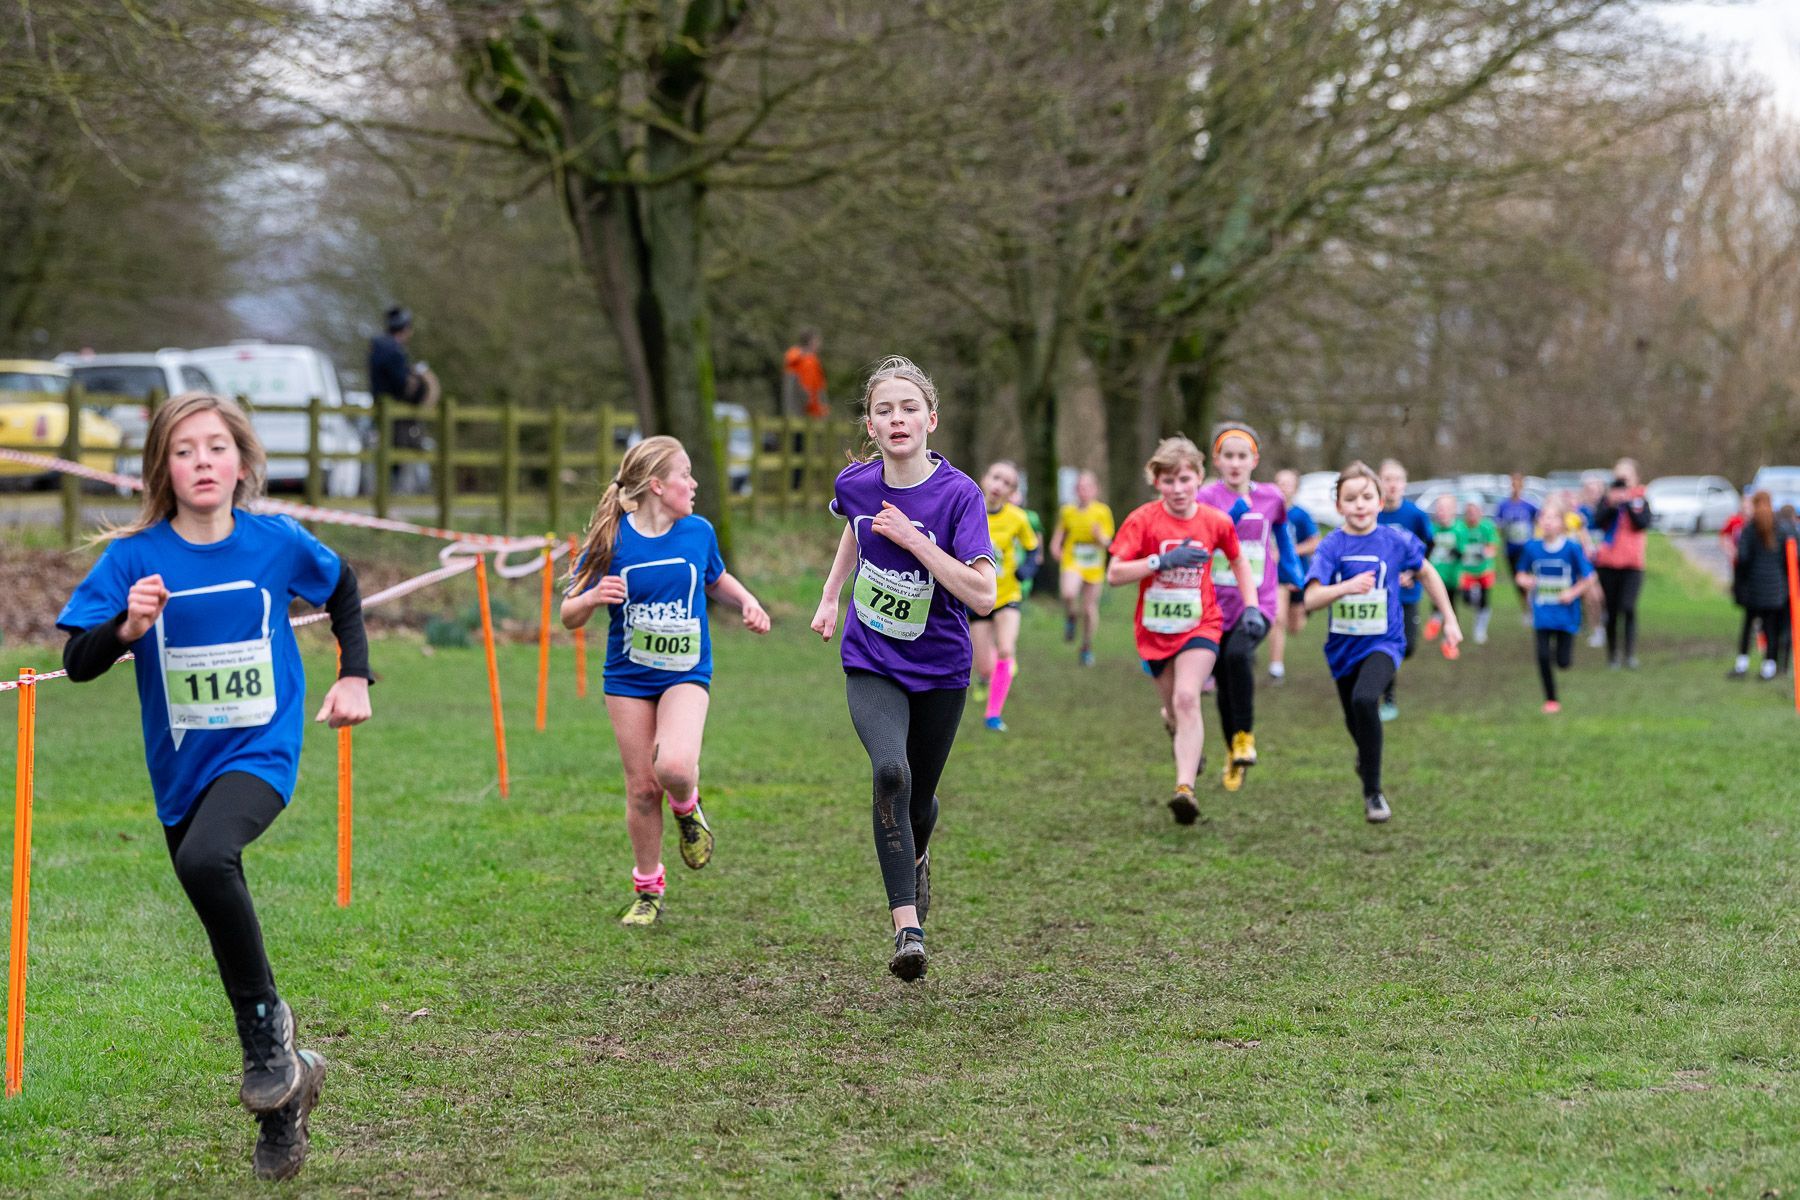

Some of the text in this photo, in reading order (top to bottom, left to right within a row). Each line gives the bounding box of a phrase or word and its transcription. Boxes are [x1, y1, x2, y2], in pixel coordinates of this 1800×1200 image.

[887, 584, 907, 596] ROWLEY
[869, 586, 911, 620] 728
[1153, 603, 1192, 618] 1445
[1340, 604, 1378, 619] 1157
[644, 635, 690, 654] 1003
[185, 668, 262, 701] 1148
